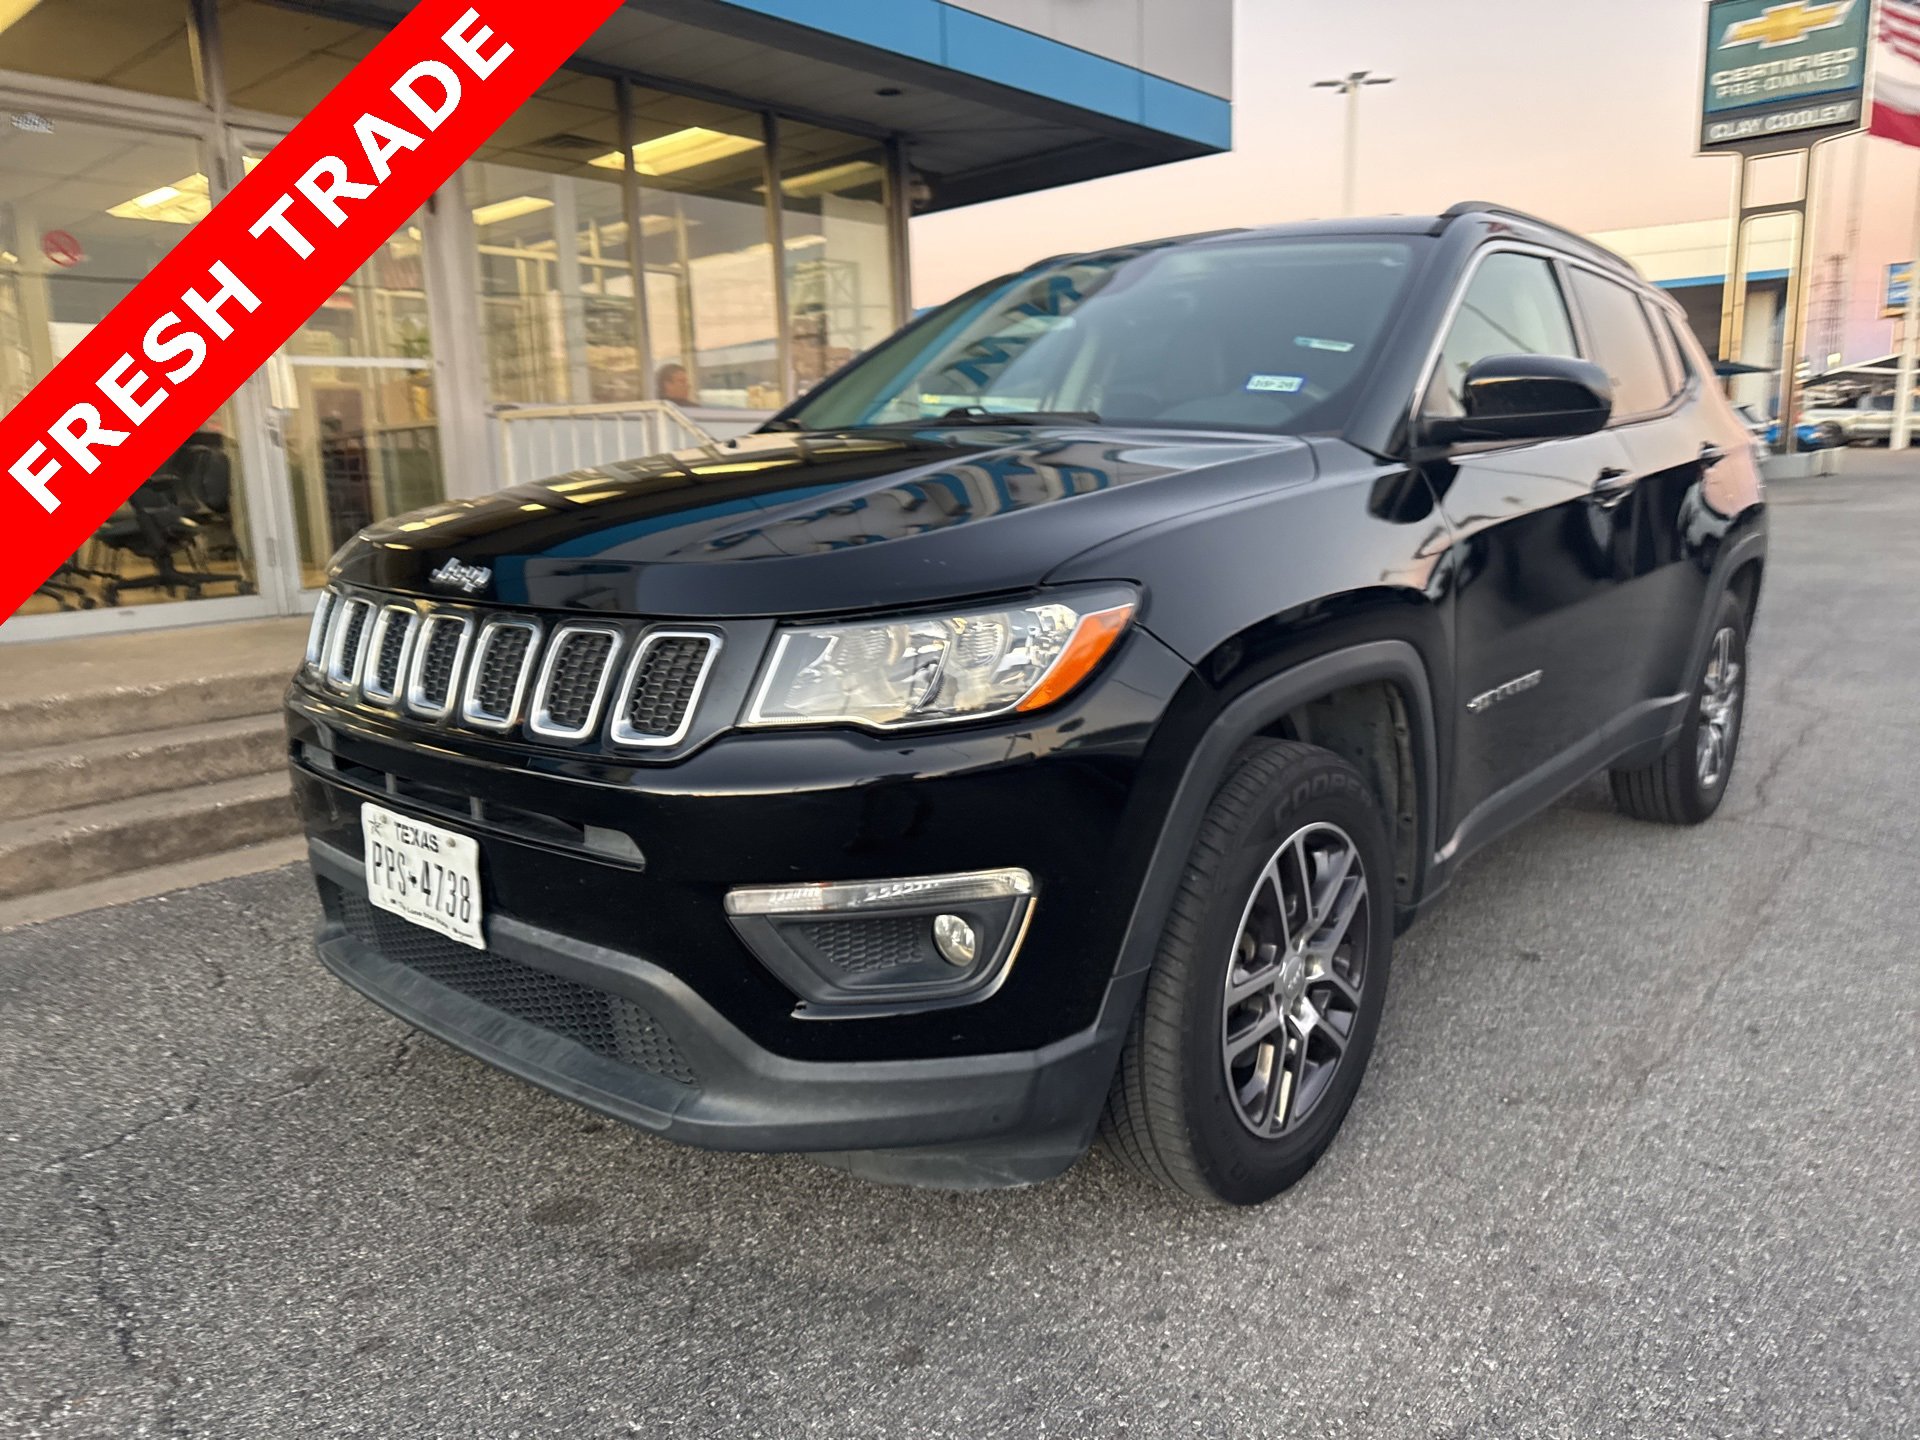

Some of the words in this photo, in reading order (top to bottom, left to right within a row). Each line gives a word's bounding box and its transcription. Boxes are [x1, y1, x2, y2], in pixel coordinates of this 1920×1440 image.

[1710, 47, 1858, 86] CERTIFIED
[1715, 64, 1849, 99] PRE-OWNED
[1709, 117, 1764, 140] CLAY
[1764, 103, 1850, 131] COOLEY
[430, 557, 492, 592] Jeep
[394, 821, 440, 853] TEXAS
